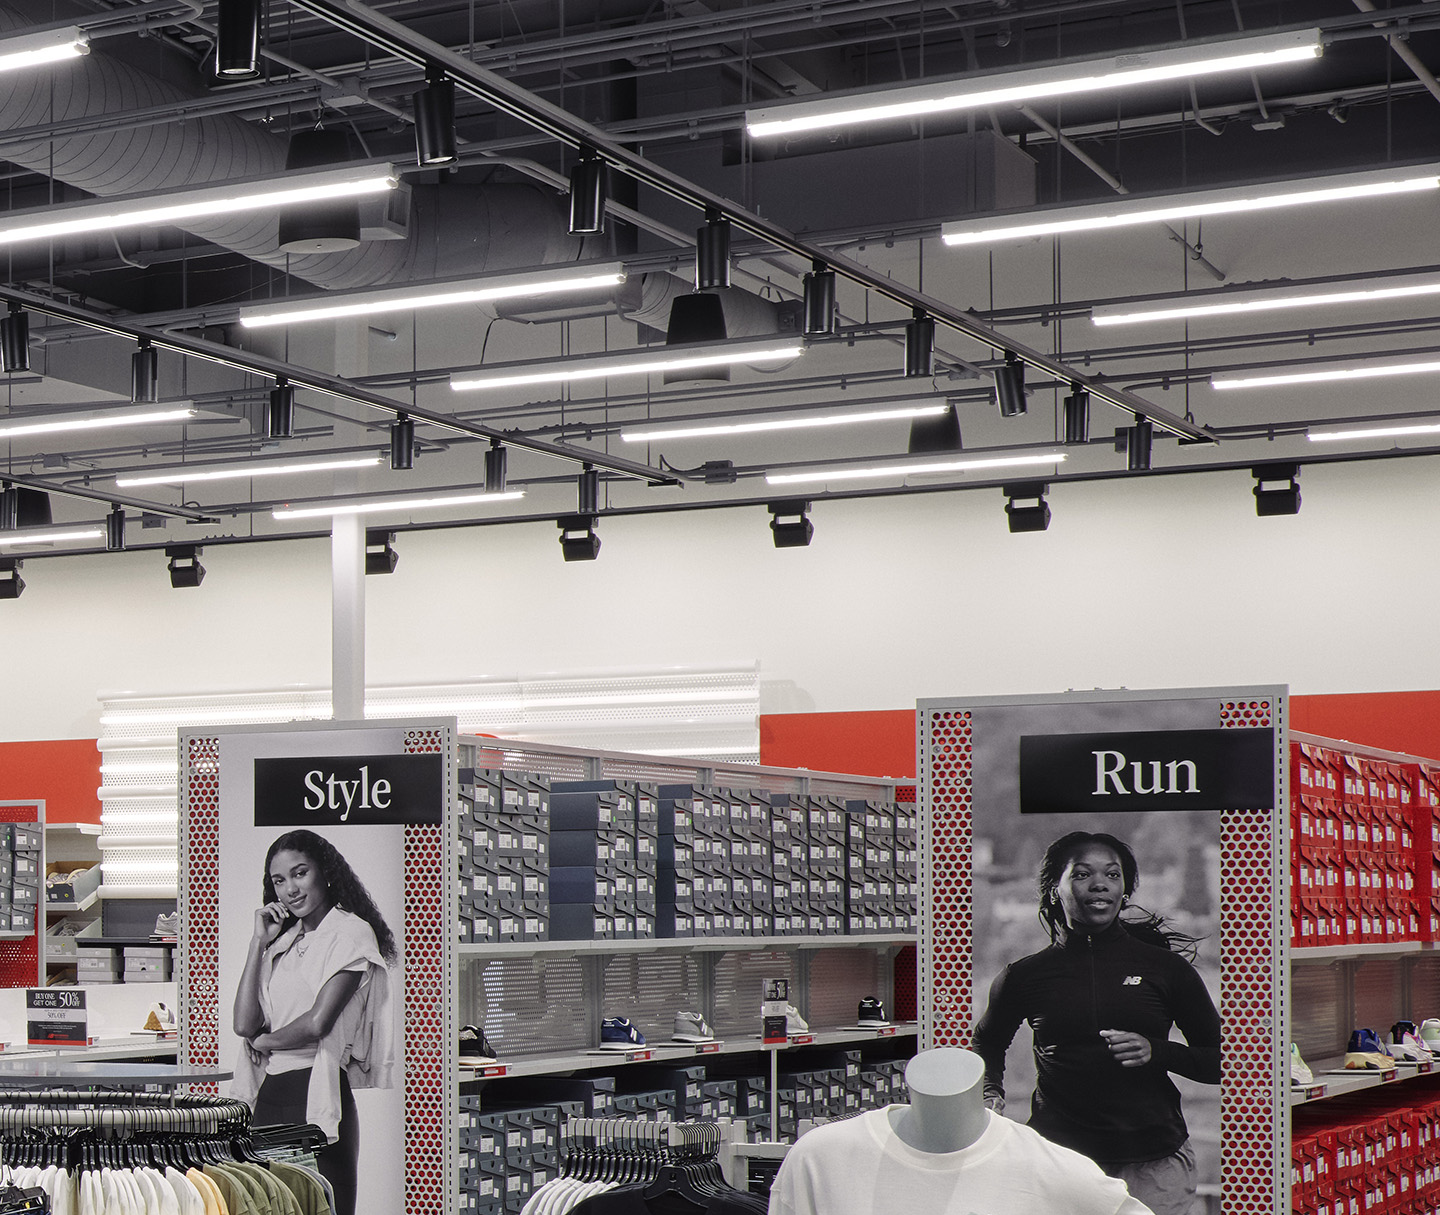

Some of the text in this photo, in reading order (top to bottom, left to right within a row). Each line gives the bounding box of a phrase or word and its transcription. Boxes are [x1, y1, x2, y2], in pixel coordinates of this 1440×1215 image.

[1091, 750, 1201, 795] Run
[302, 765, 392, 821] Style
[1123, 976, 1142, 986] NB
[59, 992, 79, 1007] 50%
